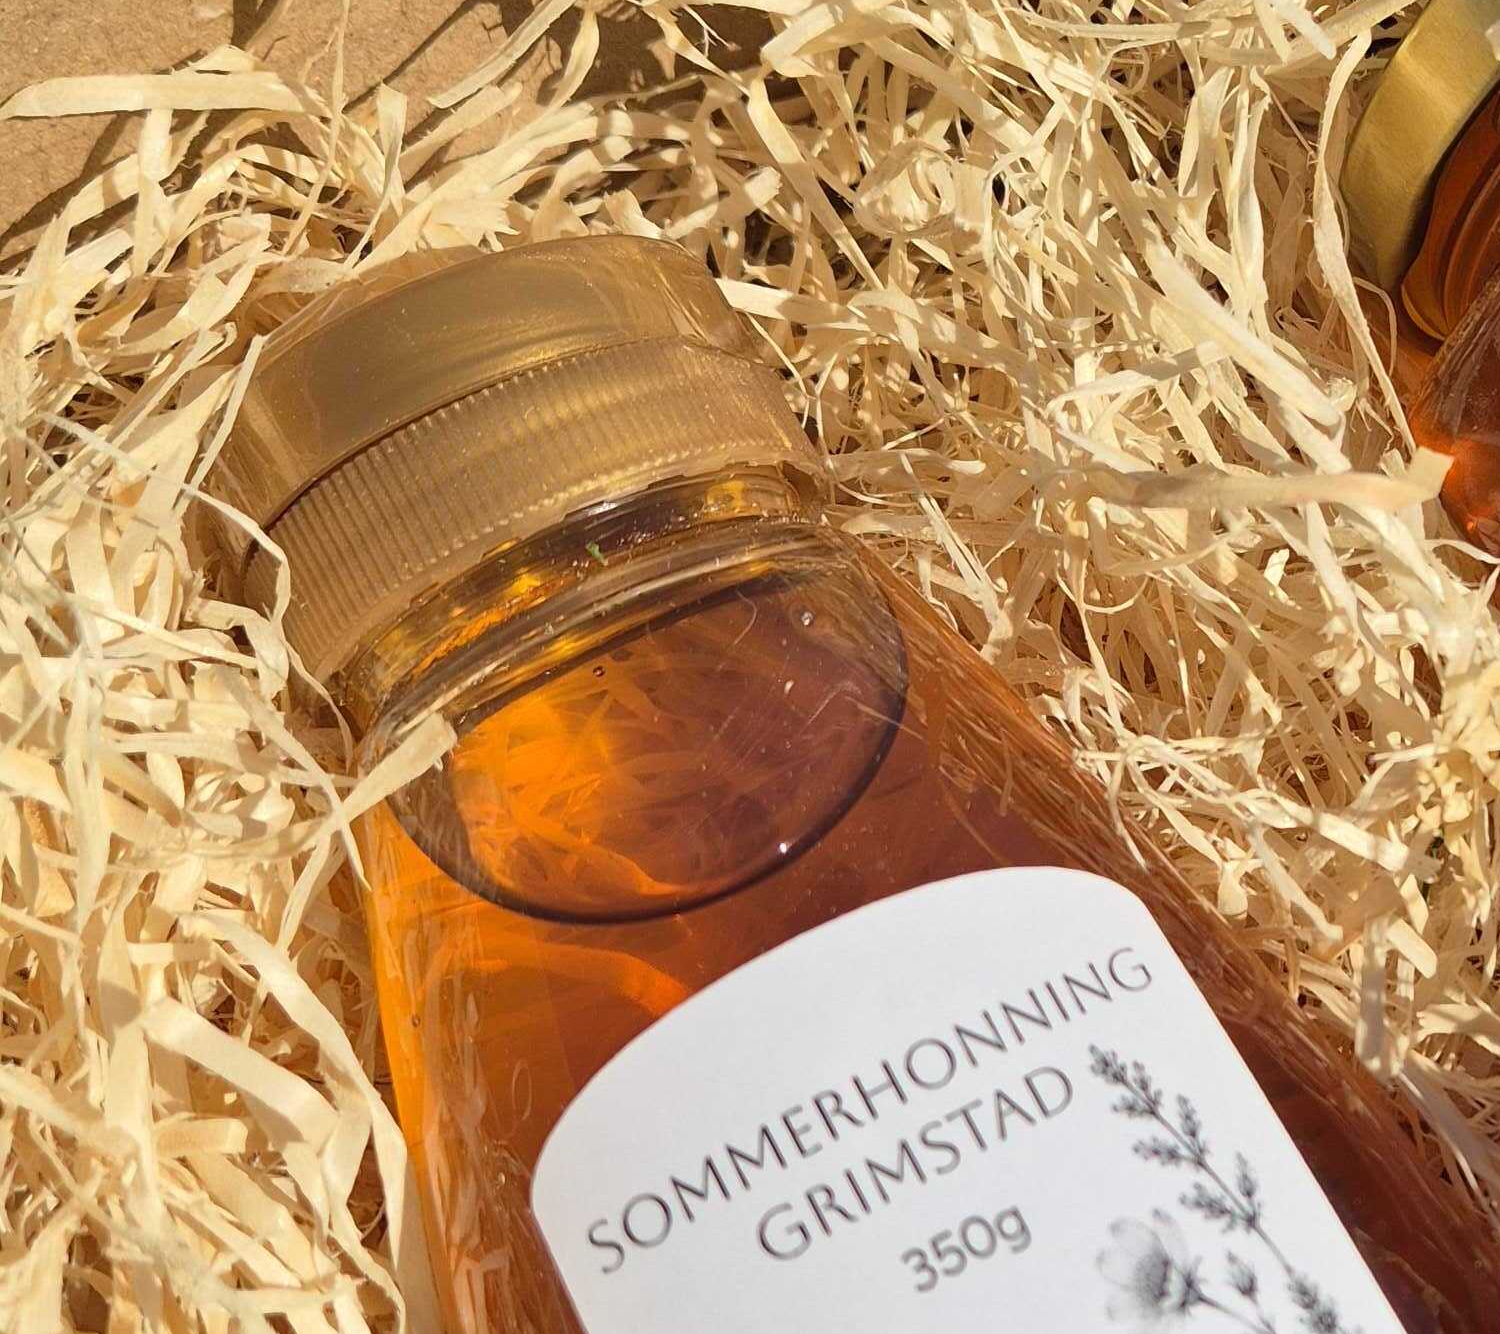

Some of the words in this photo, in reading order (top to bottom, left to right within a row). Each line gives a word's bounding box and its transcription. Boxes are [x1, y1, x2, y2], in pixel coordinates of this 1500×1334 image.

[588, 947, 1153, 1274] SOMMERHONNING
[757, 1066, 1074, 1260] GRIMSTAD
[902, 1205, 1032, 1292] 350g
